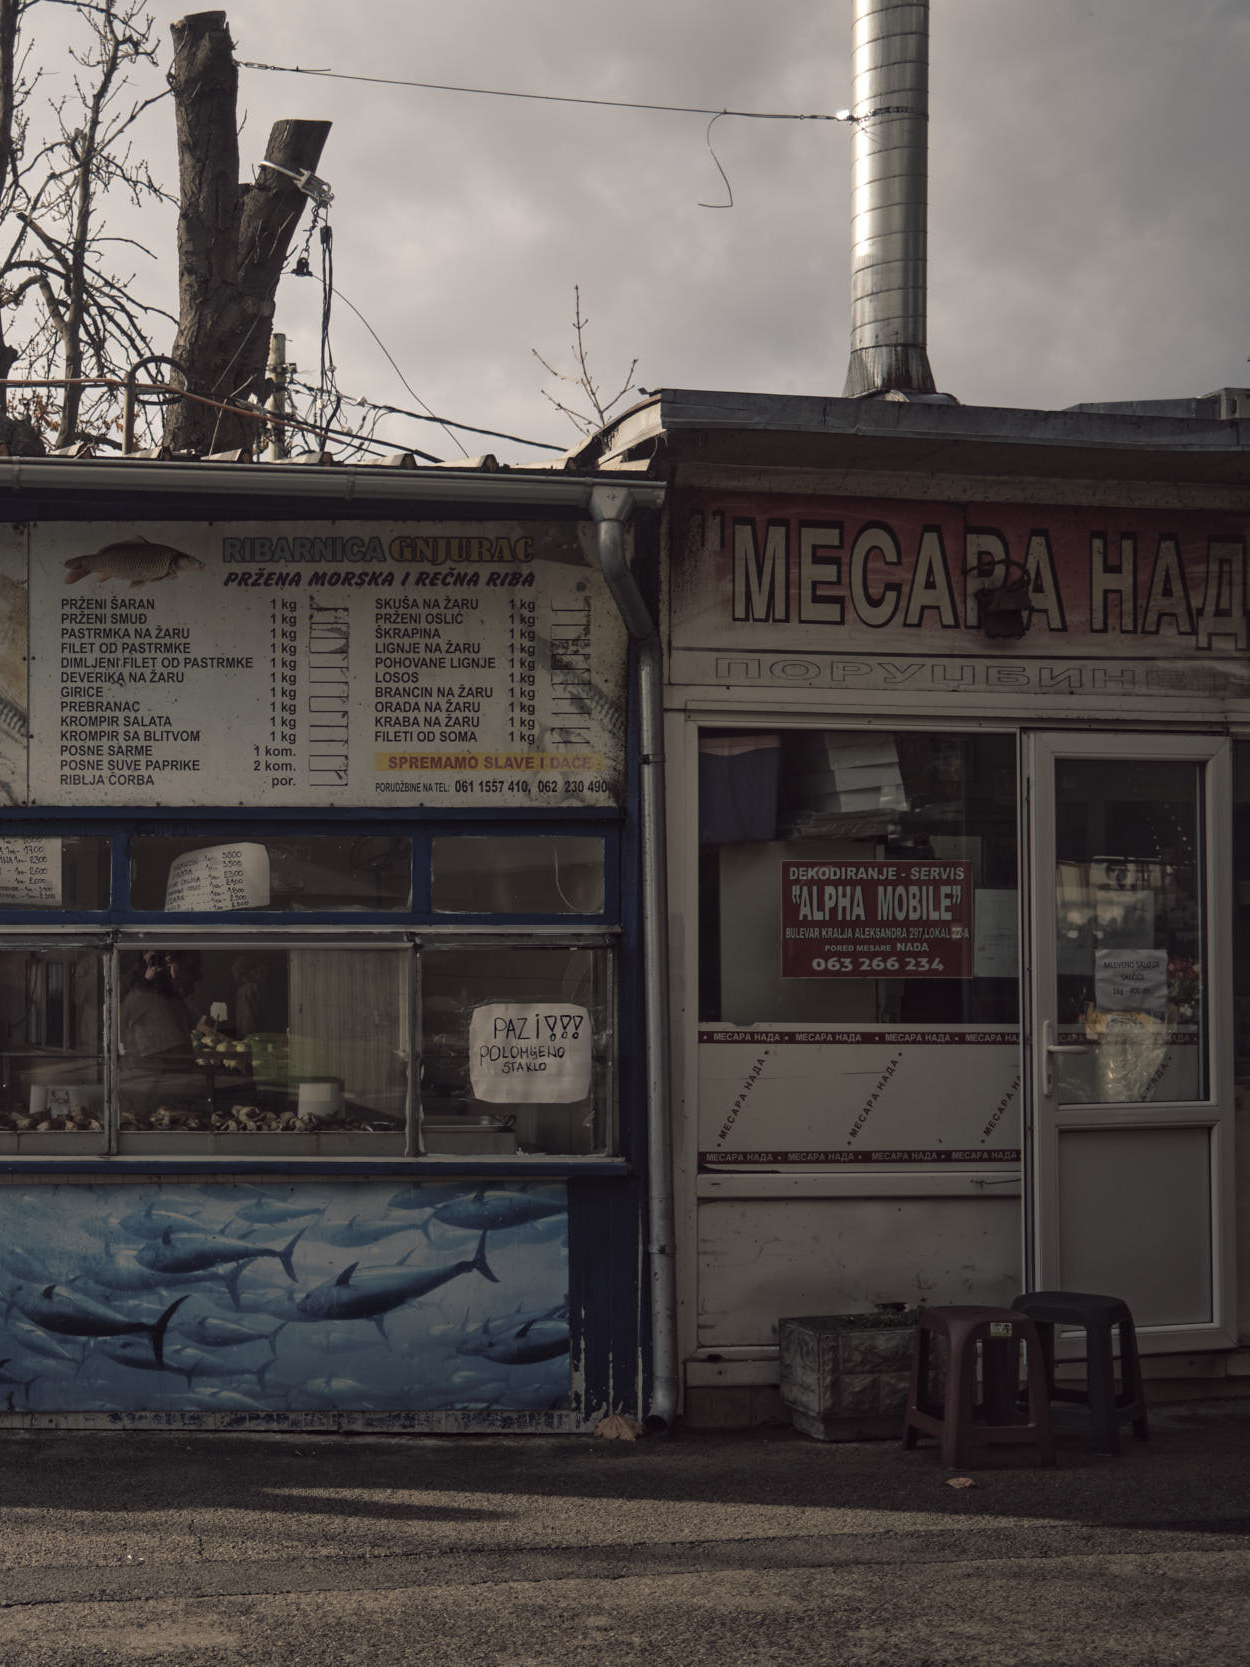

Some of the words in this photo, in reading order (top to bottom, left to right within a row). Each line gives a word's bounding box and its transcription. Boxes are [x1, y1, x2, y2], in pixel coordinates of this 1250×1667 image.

[223, 537, 385, 563] RIBARNICA
[390, 536, 535, 565] GNJURAC
[224, 568, 302, 587] PRŽENA
[309, 571, 394, 587] MORSKA
[401, 572, 409, 586] I
[415, 567, 479, 587] REČNA
[486, 572, 535, 587] RIBA
[62, 597, 106, 610] PRŽENI
[111, 596, 155, 610] ŠARAN
[62, 611, 106, 624] PRŽENI
[62, 629, 130, 639] PASTRMKA
[134, 629, 152, 639] NA
[156, 625, 190, 639] ŽARU
[62, 643, 97, 654] FILET
[99, 643, 117, 654] OD
[122, 643, 190, 654] PASTRMKE
[61, 658, 120, 669] DIMLJENI
[123, 658, 157, 668] FILET
[161, 658, 180, 669] OD
[184, 658, 253, 668] PASTRMKE
[61, 672, 125, 683] DEVERIKA
[129, 672, 146, 683] NA
[150, 669, 184, 683] ŽARU
[61, 687, 103, 698] GIRICE
[61, 701, 140, 712] PREBRANAC
[61, 716, 119, 727] KROMPIR
[123, 716, 172, 727] SALATA
[61, 731, 119, 742] KROMPIR
[123, 731, 140, 742] SA
[144, 731, 200, 742] BLITVOM
[61, 746, 104, 757] POSNE
[108, 746, 153, 757] SARME
[254, 747, 260, 756] 1
[265, 746, 296, 757] kom.
[61, 760, 104, 771] POSNE
[108, 760, 142, 771] SUVE
[145, 760, 200, 771] PAPRIKE
[254, 761, 260, 771] 2
[265, 761, 296, 771] kom.
[389, 756, 478, 769] SPREMAMO
[484, 756, 534, 769] SLAVE
[540, 757, 544, 769] I
[60, 775, 105, 785] RIBLJA
[109, 772, 154, 786] ČORBA
[272, 776, 296, 788] por.
[790, 867, 897, 880] DEKODIRANJE
[911, 867, 965, 880] SERVIS
[786, 928, 820, 939] BULEVAR
[822, 928, 853, 939] KRALJA
[855, 928, 907, 939] ALEKSANDRA
[897, 943, 929, 952] NADA
[812, 958, 853, 971] 063
[859, 958, 899, 971] 266
[905, 957, 944, 972] 234
[714, 1033, 752, 1042] МЕСАРА
[755, 1033, 781, 1042] НАДА
[796, 1033, 833, 1042] МЕСАРА
[836, 1033, 862, 1043] НАДА
[502, 1062, 547, 1074] STAKLO
[719, 1093, 748, 1139] МЕСАРА
[744, 1058, 766, 1090] НАДА
[849, 1092, 879, 1138] МЕСАРА
[877, 1059, 899, 1091] НАДА
[706, 1153, 744, 1161] МЕСАРА
[747, 1153, 773, 1162] НАДА
[788, 1152, 826, 1161] МЕСАРА
[828, 1152, 854, 1162] НАДА
